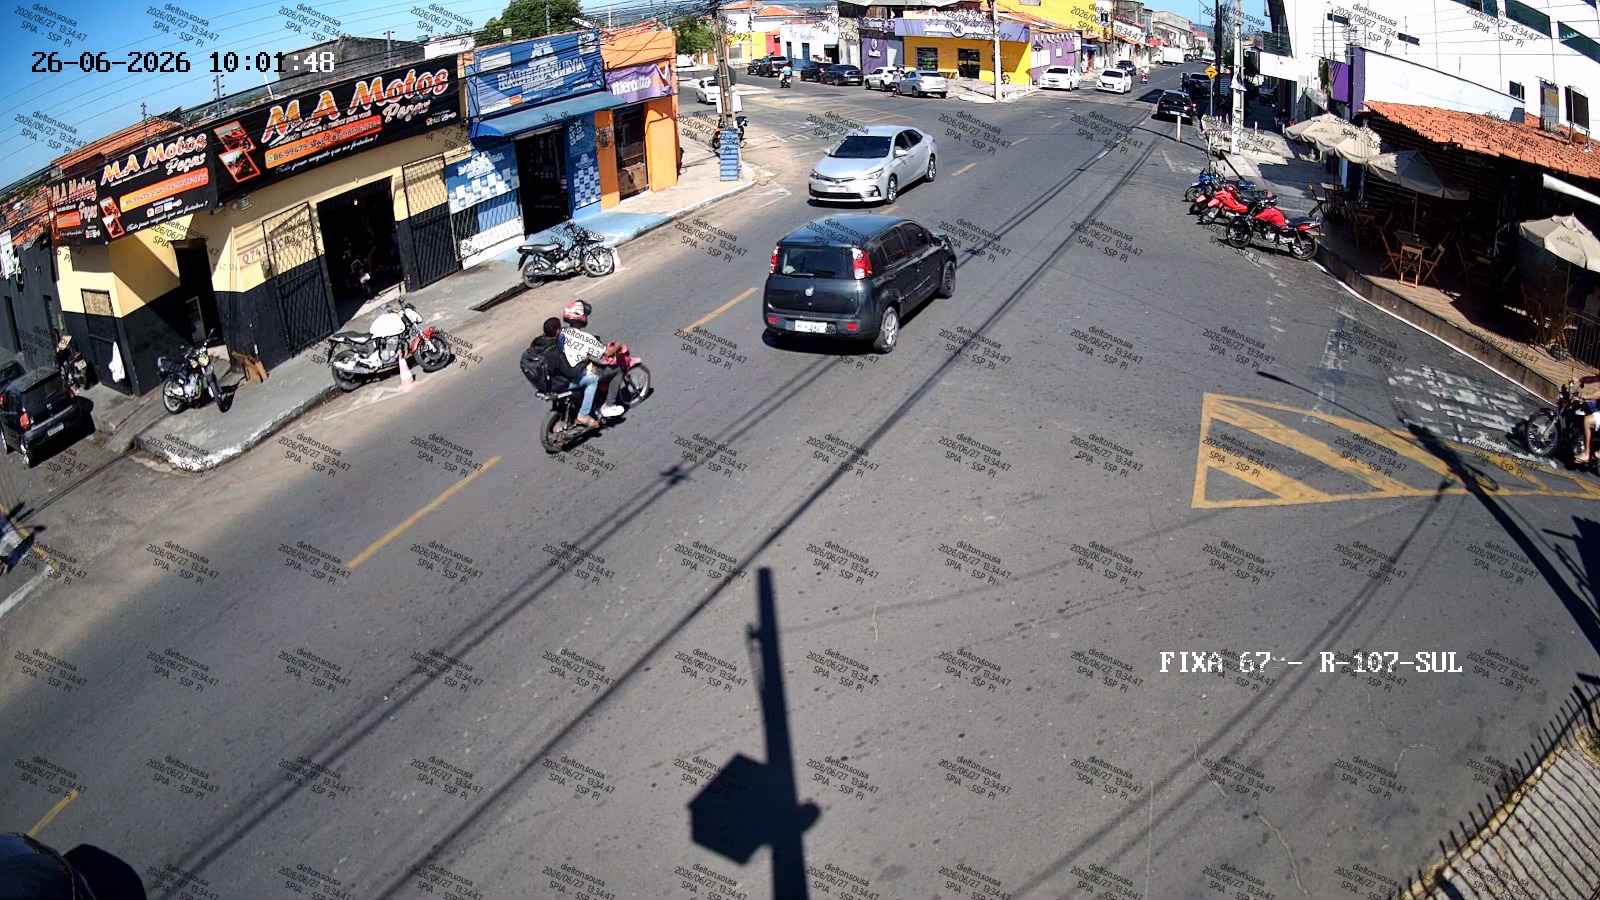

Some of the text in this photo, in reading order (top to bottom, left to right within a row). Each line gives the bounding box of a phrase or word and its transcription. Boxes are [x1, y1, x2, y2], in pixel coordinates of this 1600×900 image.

[347, 68, 449, 115] Motos
[143, 133, 207, 168] Motos
[273, 151, 284, 161] 86
